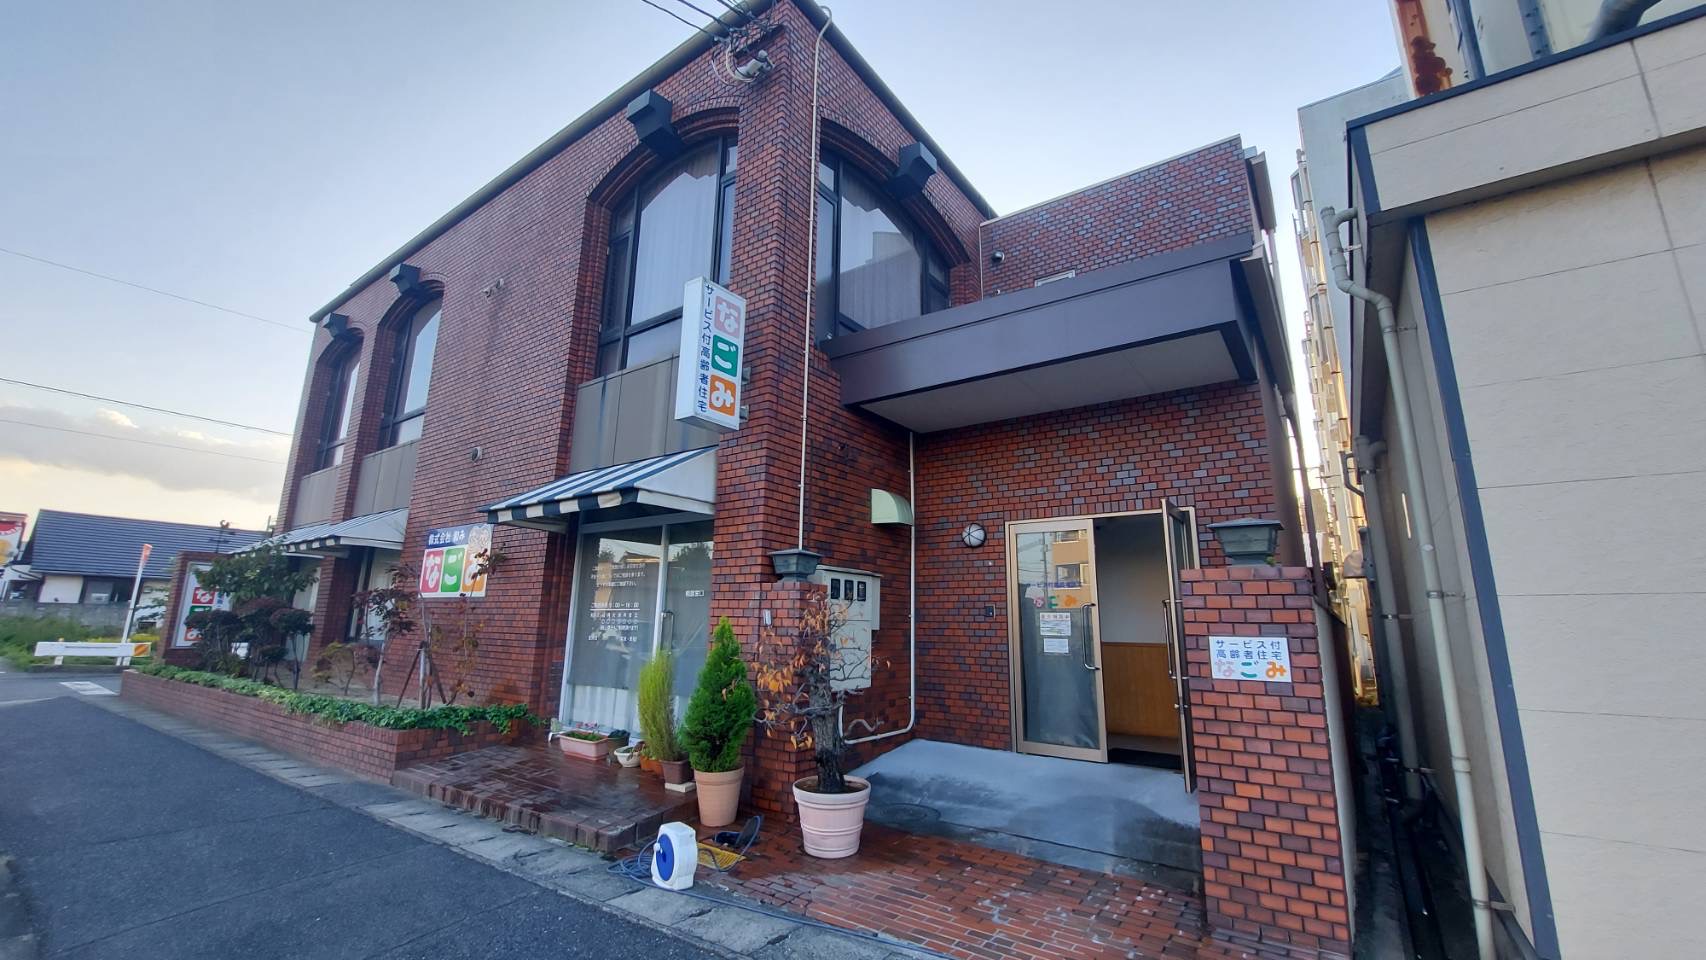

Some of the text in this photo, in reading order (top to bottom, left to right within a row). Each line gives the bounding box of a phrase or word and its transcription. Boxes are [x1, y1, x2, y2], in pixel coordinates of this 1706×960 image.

[697, 284, 714, 413] サービス付高齢者住宅
[711, 300, 739, 408] なごみ
[1215, 639, 1281, 650] サービス付
[1216, 649, 1282, 661] 高齢者住宅
[1215, 660, 1287, 679] なごみ
